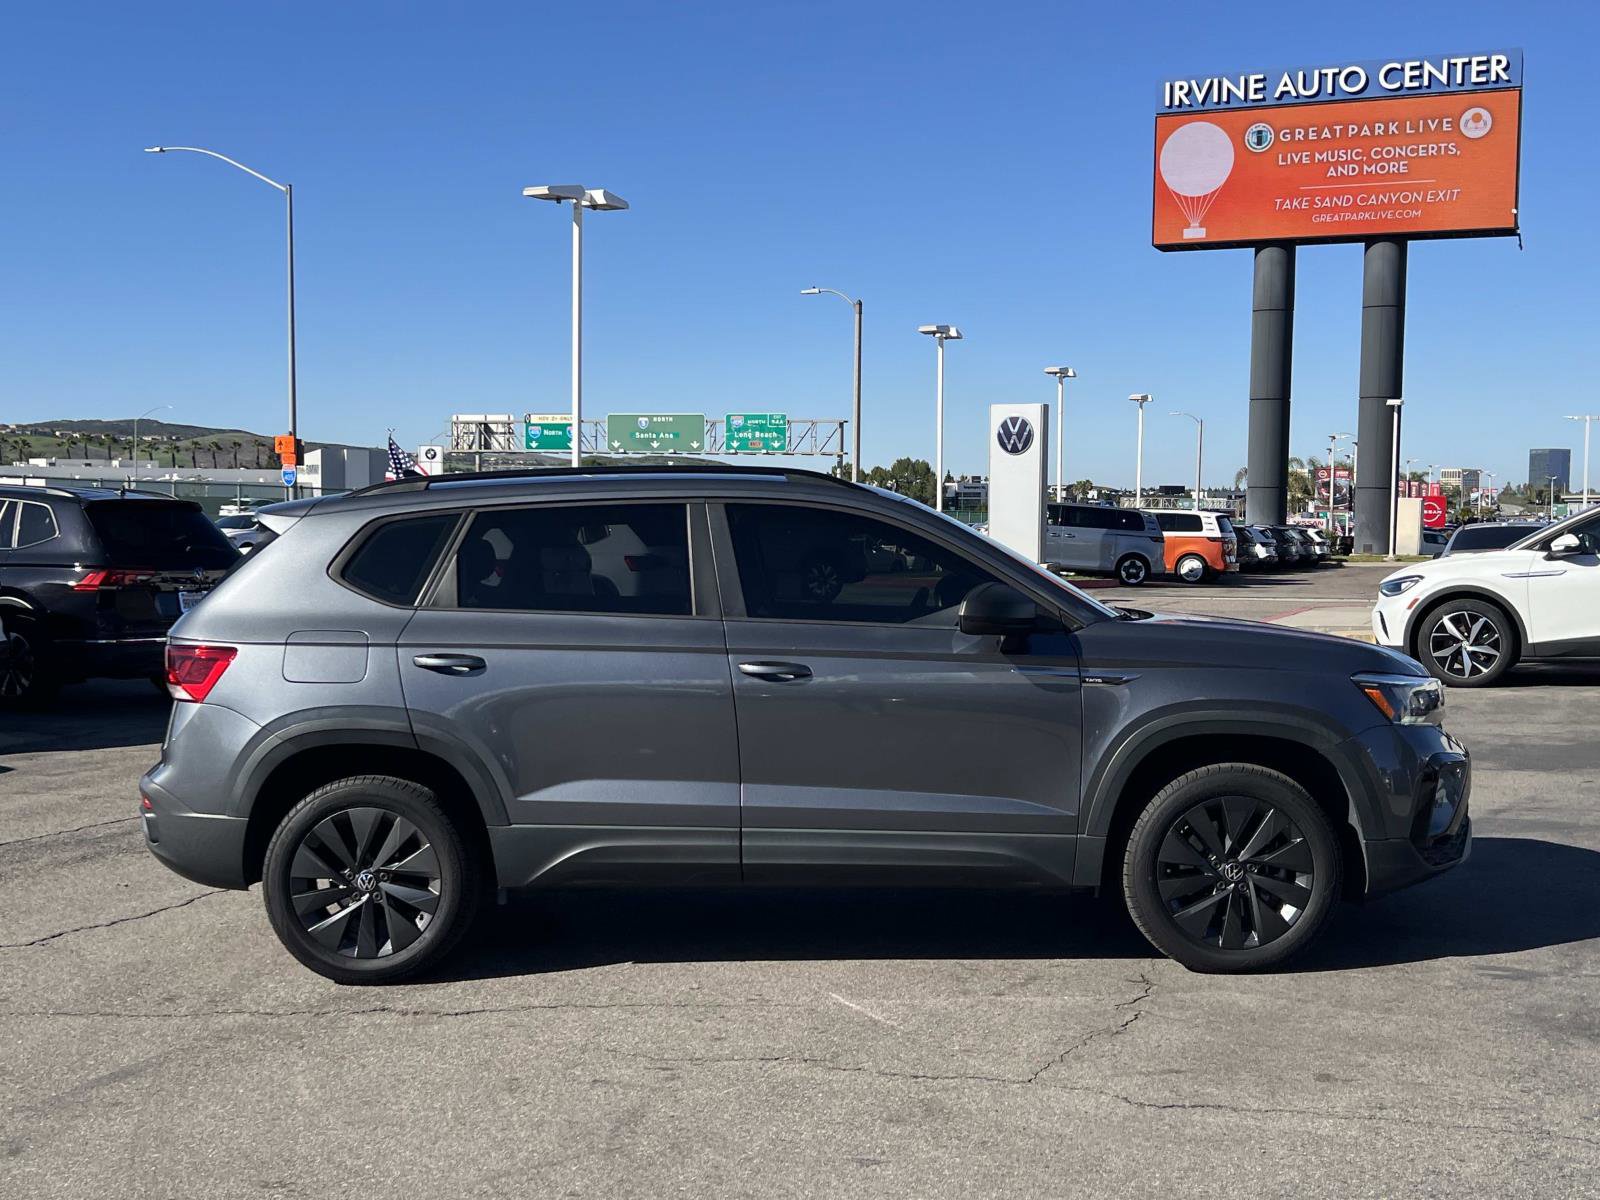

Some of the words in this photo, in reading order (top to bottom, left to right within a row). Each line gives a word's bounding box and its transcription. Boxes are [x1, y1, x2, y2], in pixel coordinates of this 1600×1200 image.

[1164, 73, 1265, 107] IRVINE
[1274, 65, 1367, 99] AUTO
[1378, 54, 1510, 90] CENTER
[1279, 124, 1342, 142] GREAT
[1348, 120, 1400, 138] PARK
[1405, 117, 1453, 134] LIVE
[1278, 151, 1311, 166] LIVE
[1315, 148, 1367, 164] MUSIC,
[1371, 142, 1461, 160] CONCERTS,
[1326, 163, 1359, 178] AND
[1363, 160, 1409, 175] MORE
[1274, 198, 1310, 211] TAKE
[1313, 194, 1354, 209] SAND
[1356, 191, 1423, 207] CANYON
[1426, 188, 1461, 203] EXIT
[1312, 208, 1422, 223] GREATPARKLIVE.COM
[635, 431, 656, 439] Santa
[734, 431, 752, 439] Long
